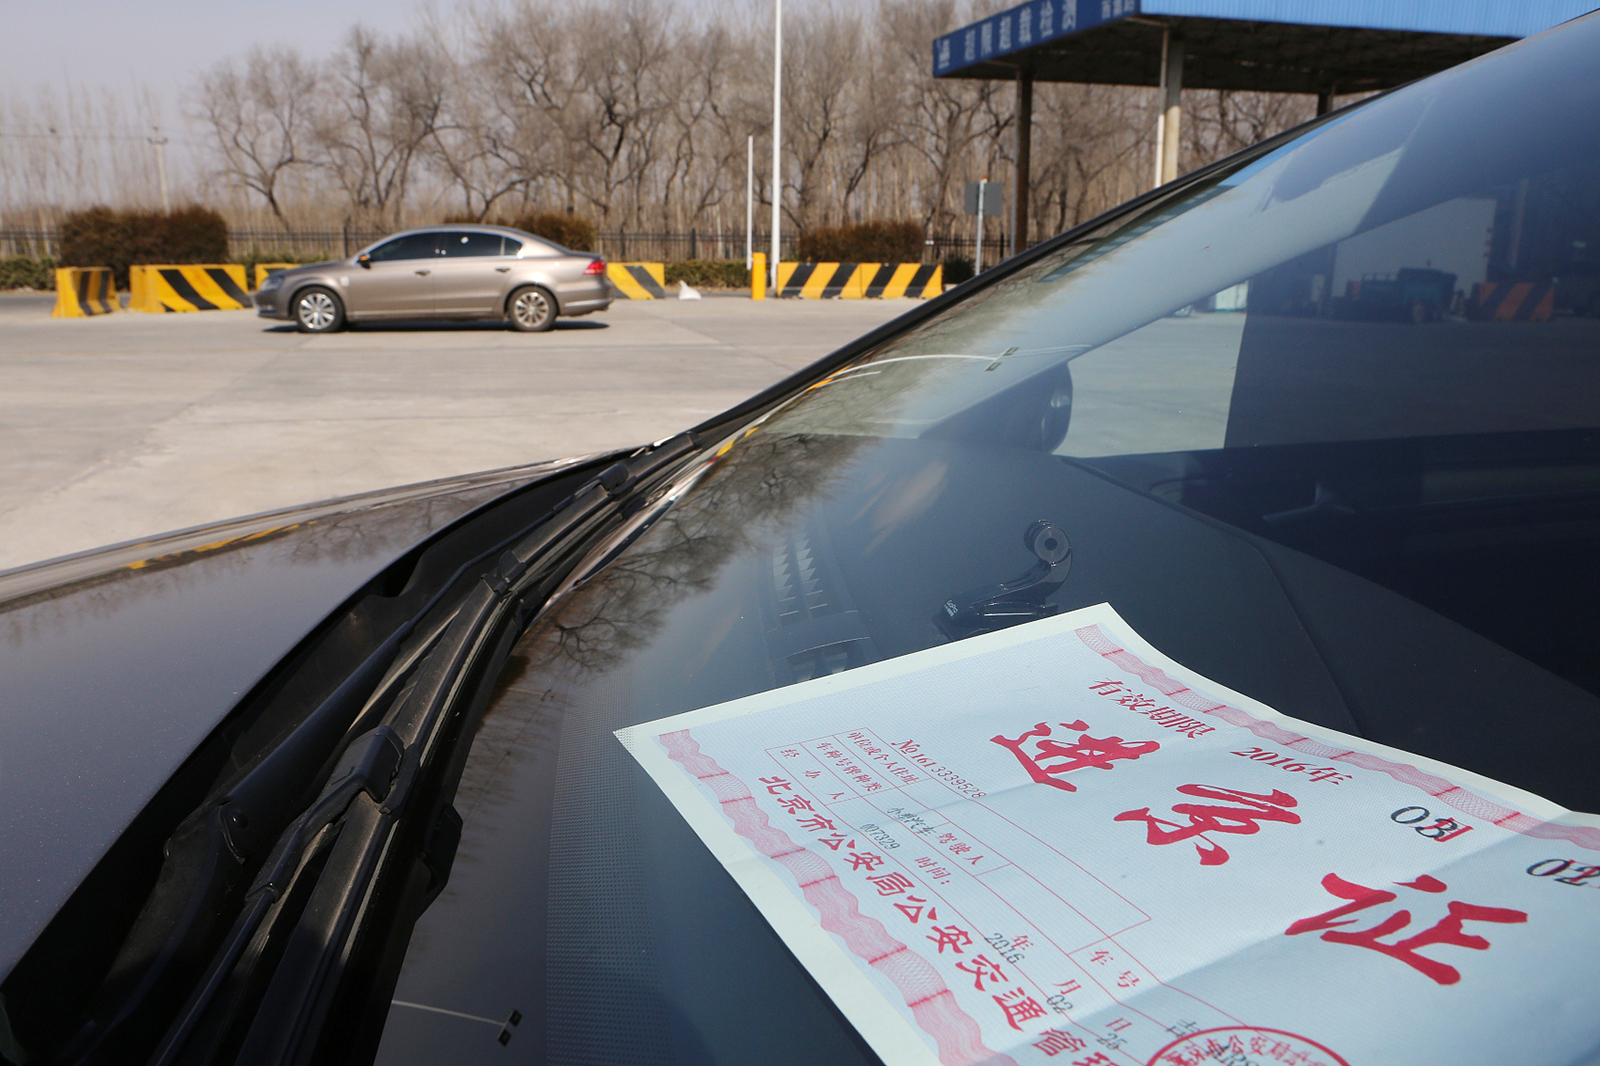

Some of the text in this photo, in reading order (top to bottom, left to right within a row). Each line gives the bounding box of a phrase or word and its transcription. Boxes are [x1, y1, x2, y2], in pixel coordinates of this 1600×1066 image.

[1089, 678, 1215, 739] 有效期限
[1230, 747, 1353, 785] 2016年
[938, 832, 984, 866] 驾驶人
[984, 932, 1025, 964] 2016
[1046, 994, 1074, 1014] 02
[1052, 979, 1082, 995] 月
[1106, 1017, 1132, 1032] 日
